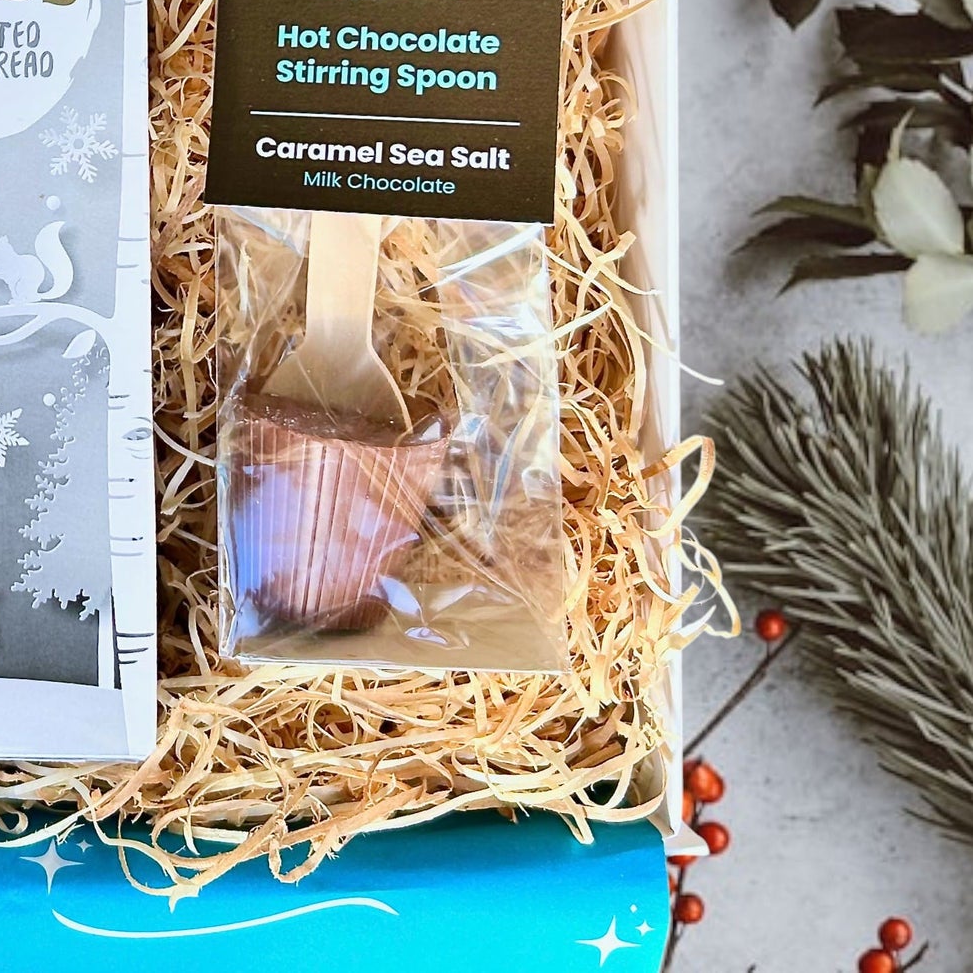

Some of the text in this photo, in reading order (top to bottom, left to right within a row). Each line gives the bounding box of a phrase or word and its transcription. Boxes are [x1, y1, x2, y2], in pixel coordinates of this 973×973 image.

[277, 24, 501, 54] Hot Chocolate
[276, 58, 497, 95] Stirring Spoon
[255, 136, 511, 171] Caramel Sea Salt
[303, 171, 456, 195] Milk Chocolate
